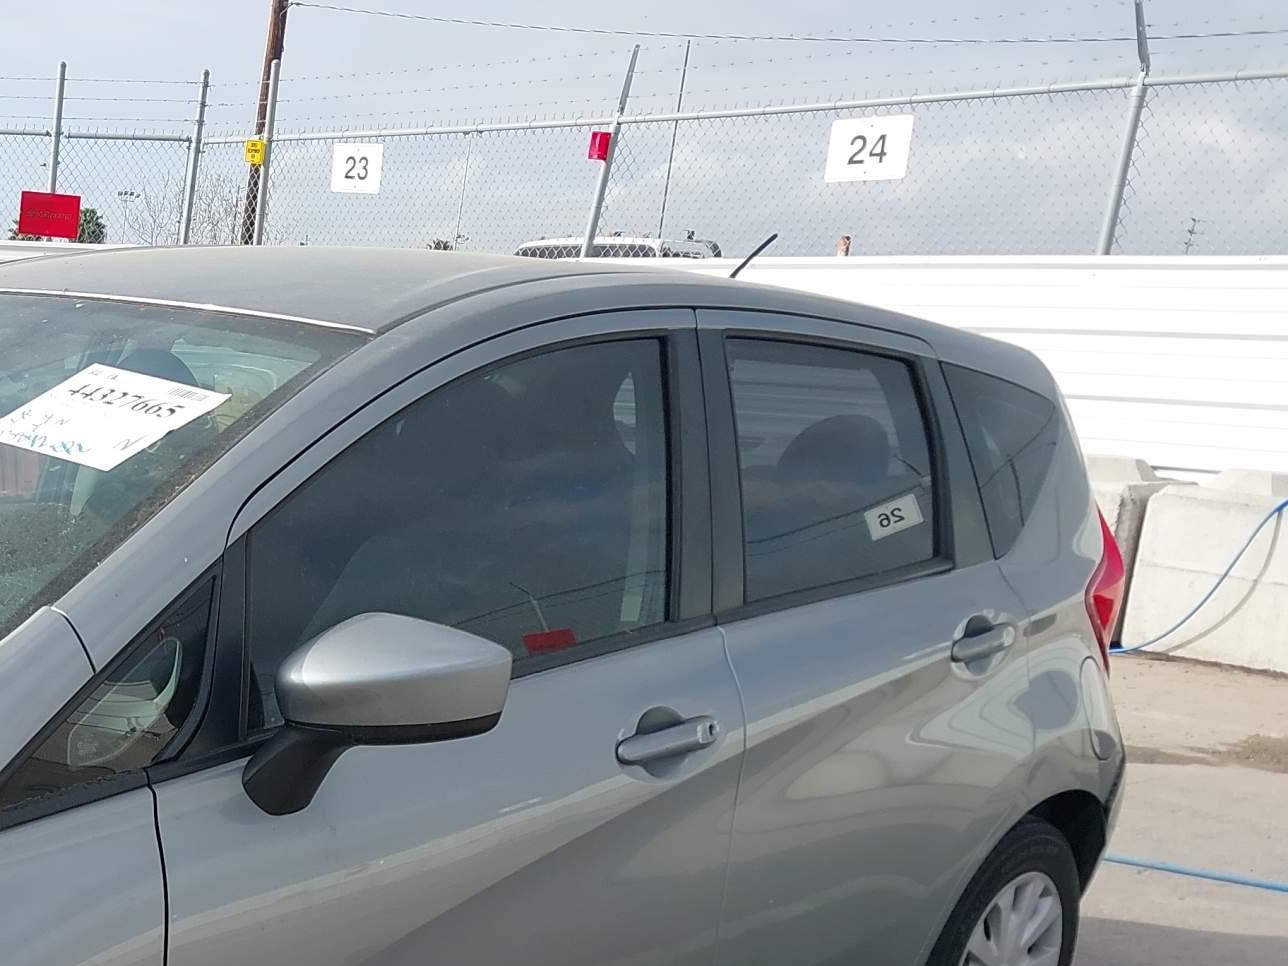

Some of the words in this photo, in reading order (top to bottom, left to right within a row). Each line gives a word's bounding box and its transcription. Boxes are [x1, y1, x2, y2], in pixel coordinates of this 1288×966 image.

[847, 134, 887, 165] 24
[344, 156, 369, 180] 23
[68, 383, 186, 418] 44327665
